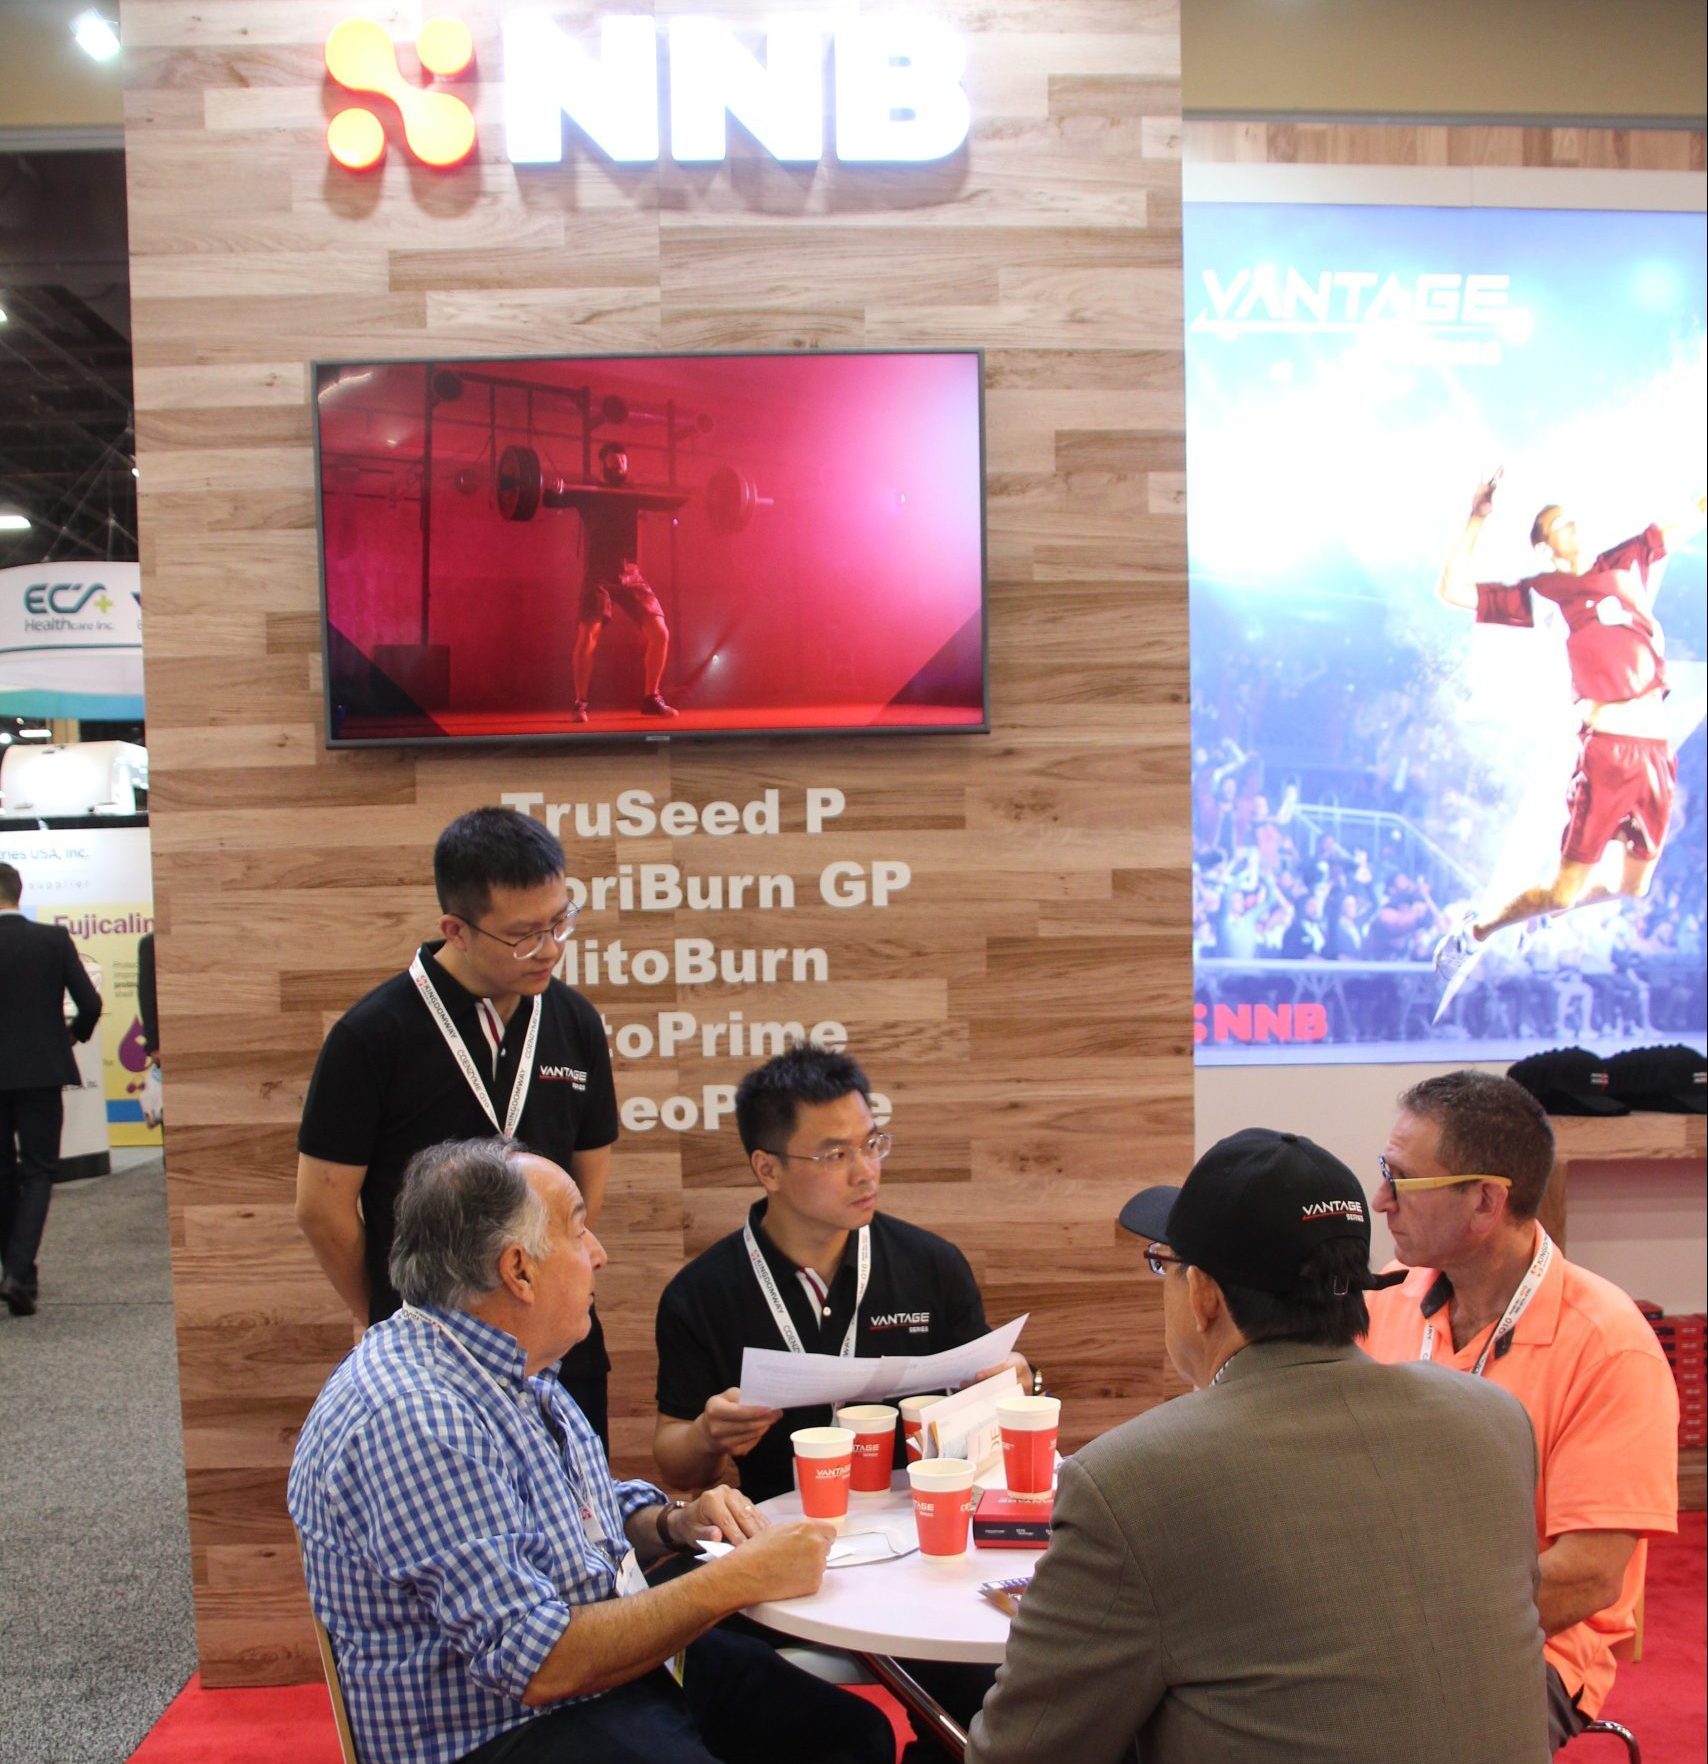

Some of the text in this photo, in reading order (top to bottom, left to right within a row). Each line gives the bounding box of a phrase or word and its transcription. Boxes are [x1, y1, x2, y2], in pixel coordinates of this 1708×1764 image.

[504, 14, 971, 163] NNB
[1202, 267, 1510, 322] VANTAGE
[25, 618, 93, 632] Healthcare
[501, 787, 846, 837] TruSeed P
[566, 860, 912, 911] oriBurn GP
[424, 982, 457, 1040] KINGDOMWAY
[456, 1049, 482, 1095] COENZYME
[1214, 1002, 1328, 1042] NNB
[506, 1068, 527, 1127] KINGDOMWAY
[539, 1065, 588, 1082] VANTAGE
[1302, 1200, 1363, 1216] VANTAGE
[757, 1259, 785, 1314] KINGDOMWAY
[870, 1312, 930, 1326] VANTAGE
[853, 1444, 881, 1452] TAGE
